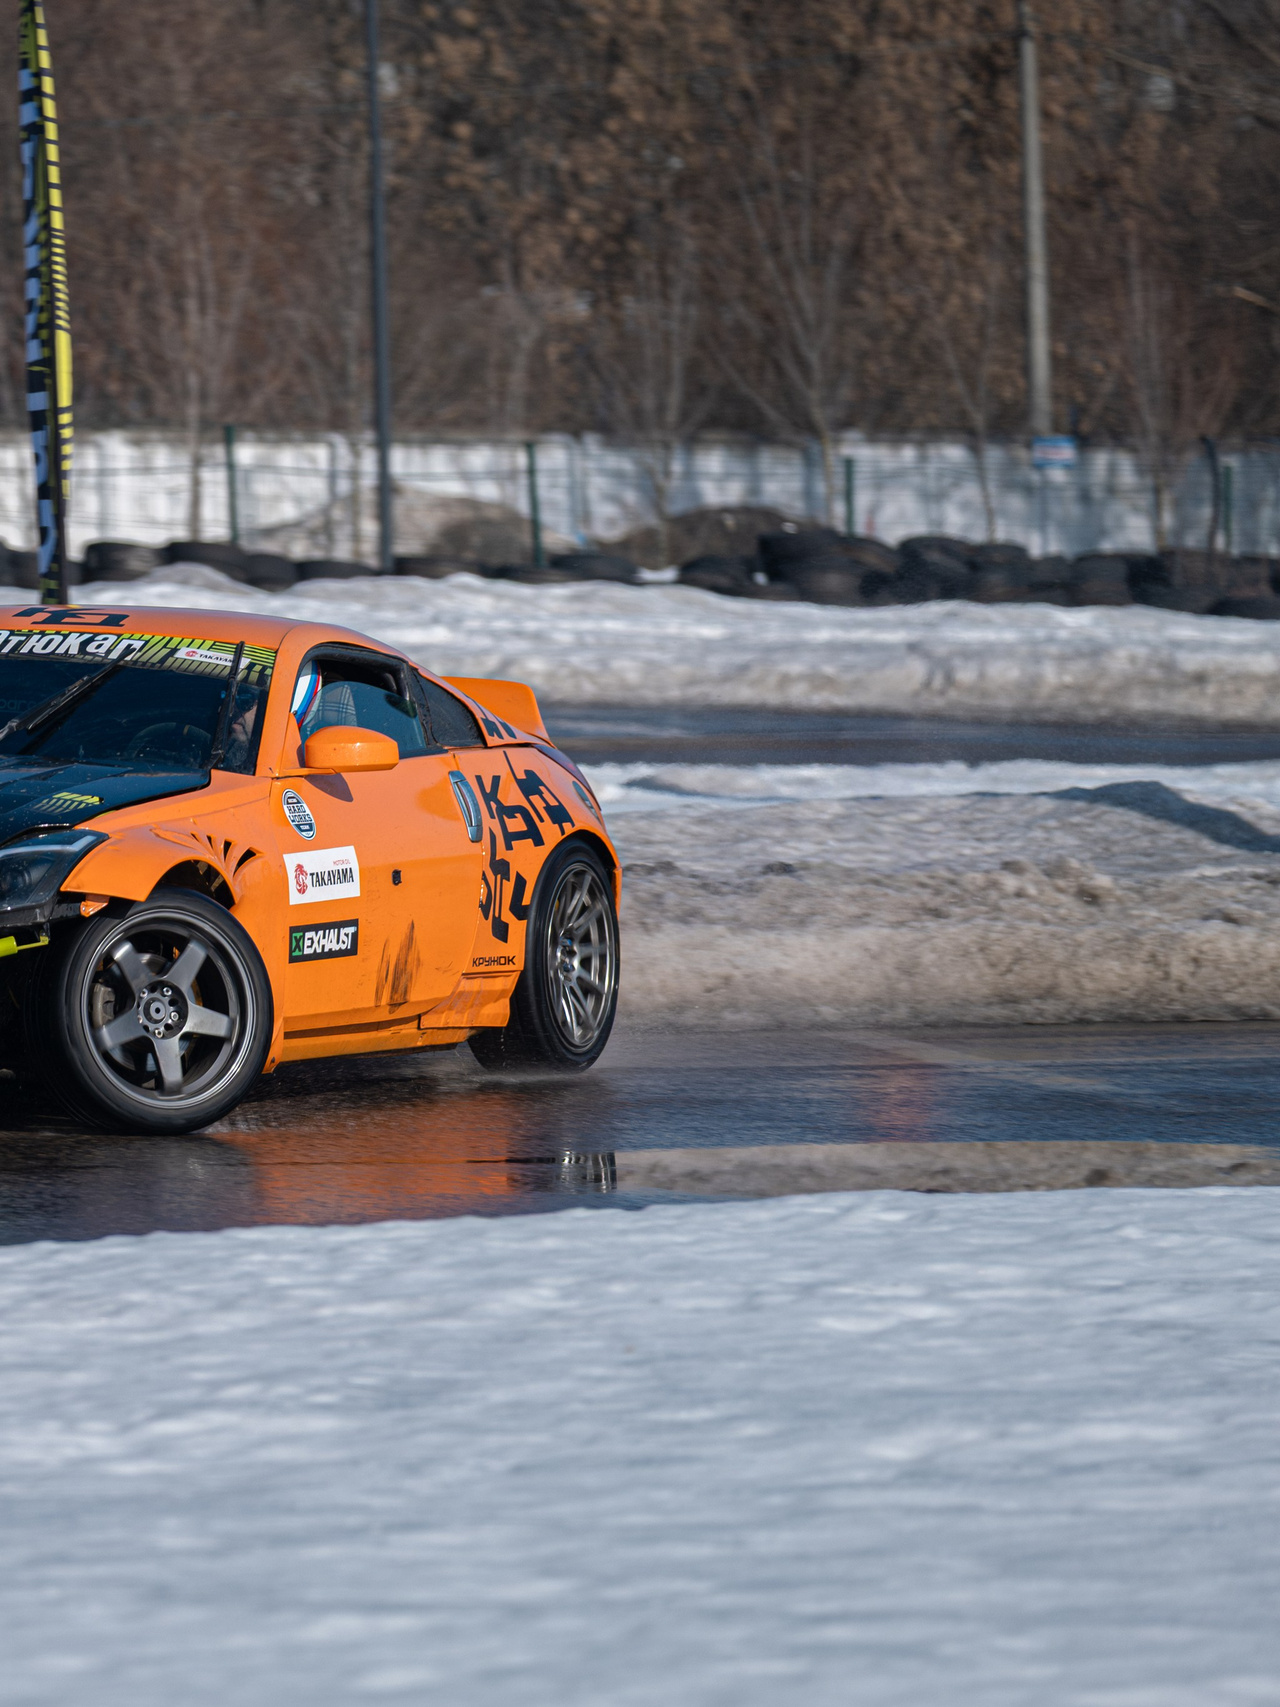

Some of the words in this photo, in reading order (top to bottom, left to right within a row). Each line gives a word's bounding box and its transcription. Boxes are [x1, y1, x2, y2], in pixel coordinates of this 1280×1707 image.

[286, 804, 307, 814] HARD
[288, 813, 313, 823] WORKS
[309, 867, 355, 888] TAKAYAMA
[303, 927, 357, 955] EXHAUST
[472, 955, 517, 968] КРУЖОК
